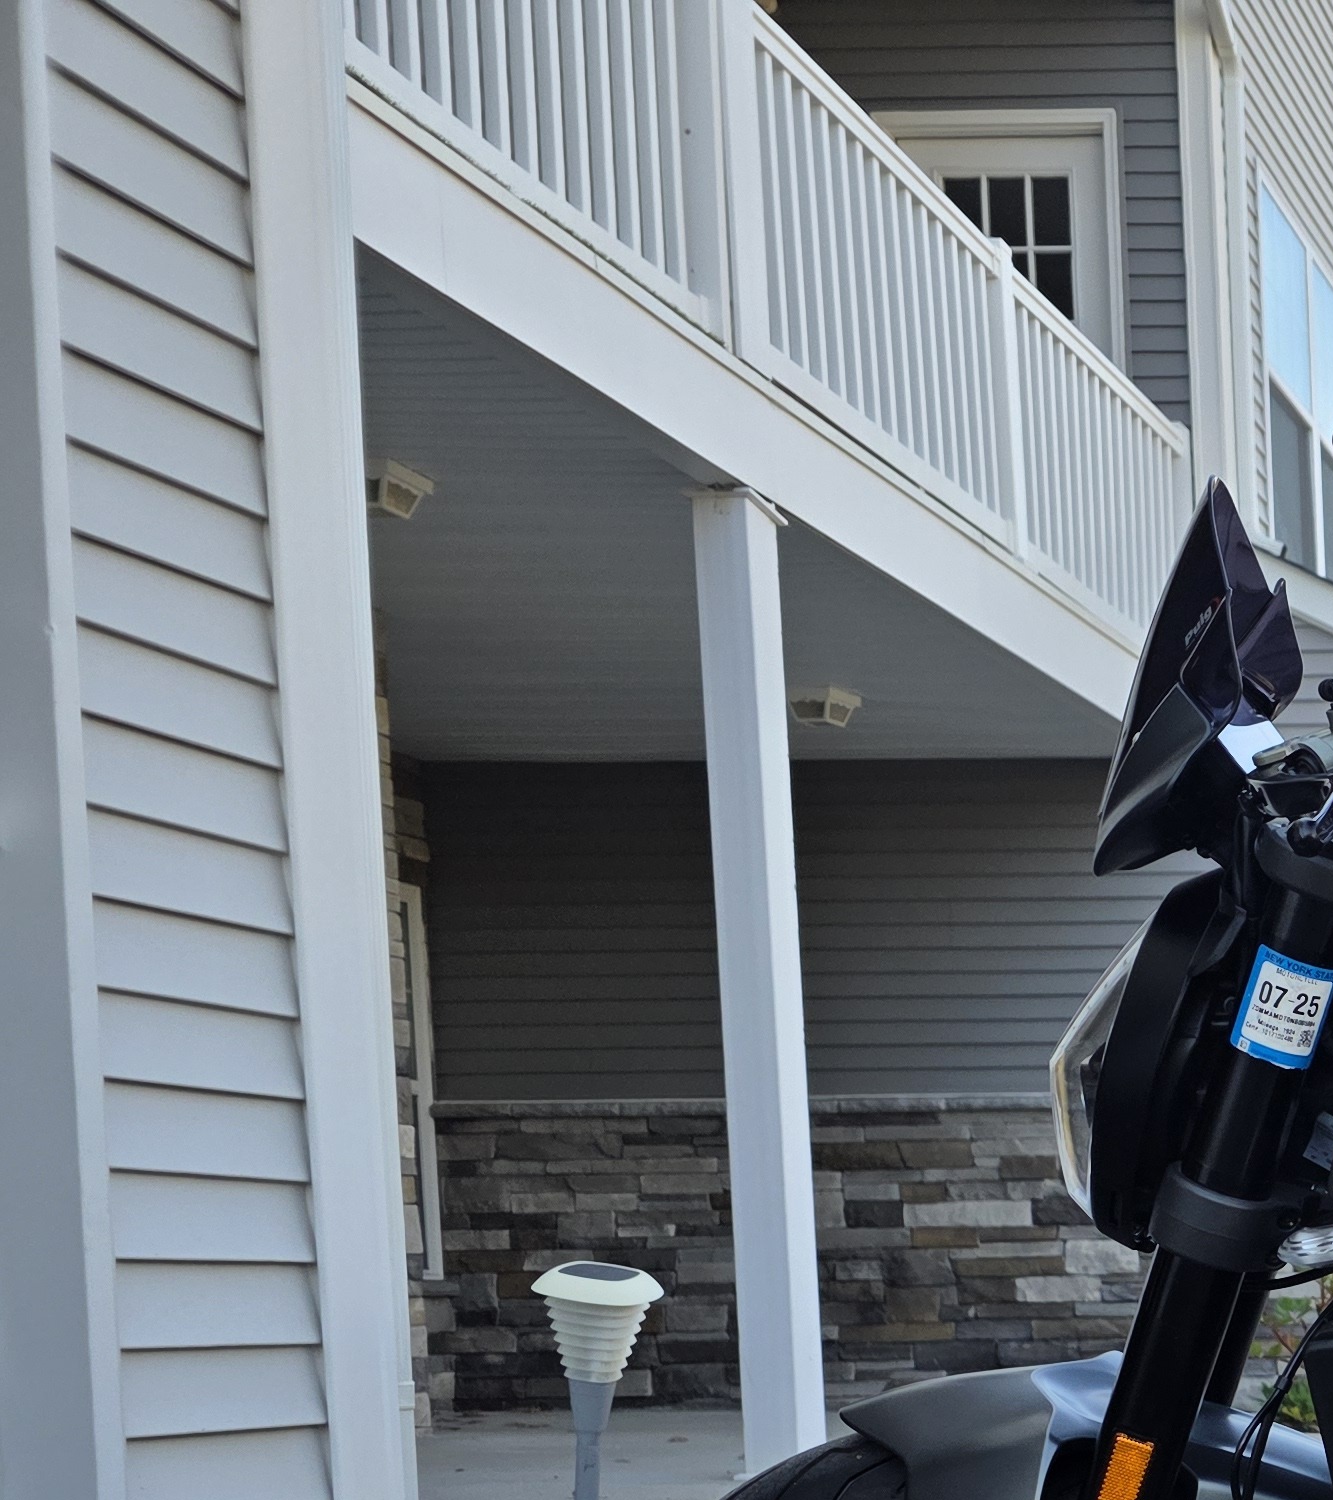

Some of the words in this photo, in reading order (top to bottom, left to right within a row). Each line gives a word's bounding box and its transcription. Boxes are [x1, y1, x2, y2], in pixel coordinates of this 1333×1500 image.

[1184, 605, 1212, 648] Puig
[1264, 950, 1284, 966] NEW
[1286, 960, 1313, 977] YORK
[1258, 980, 1321, 1018] 07-25
